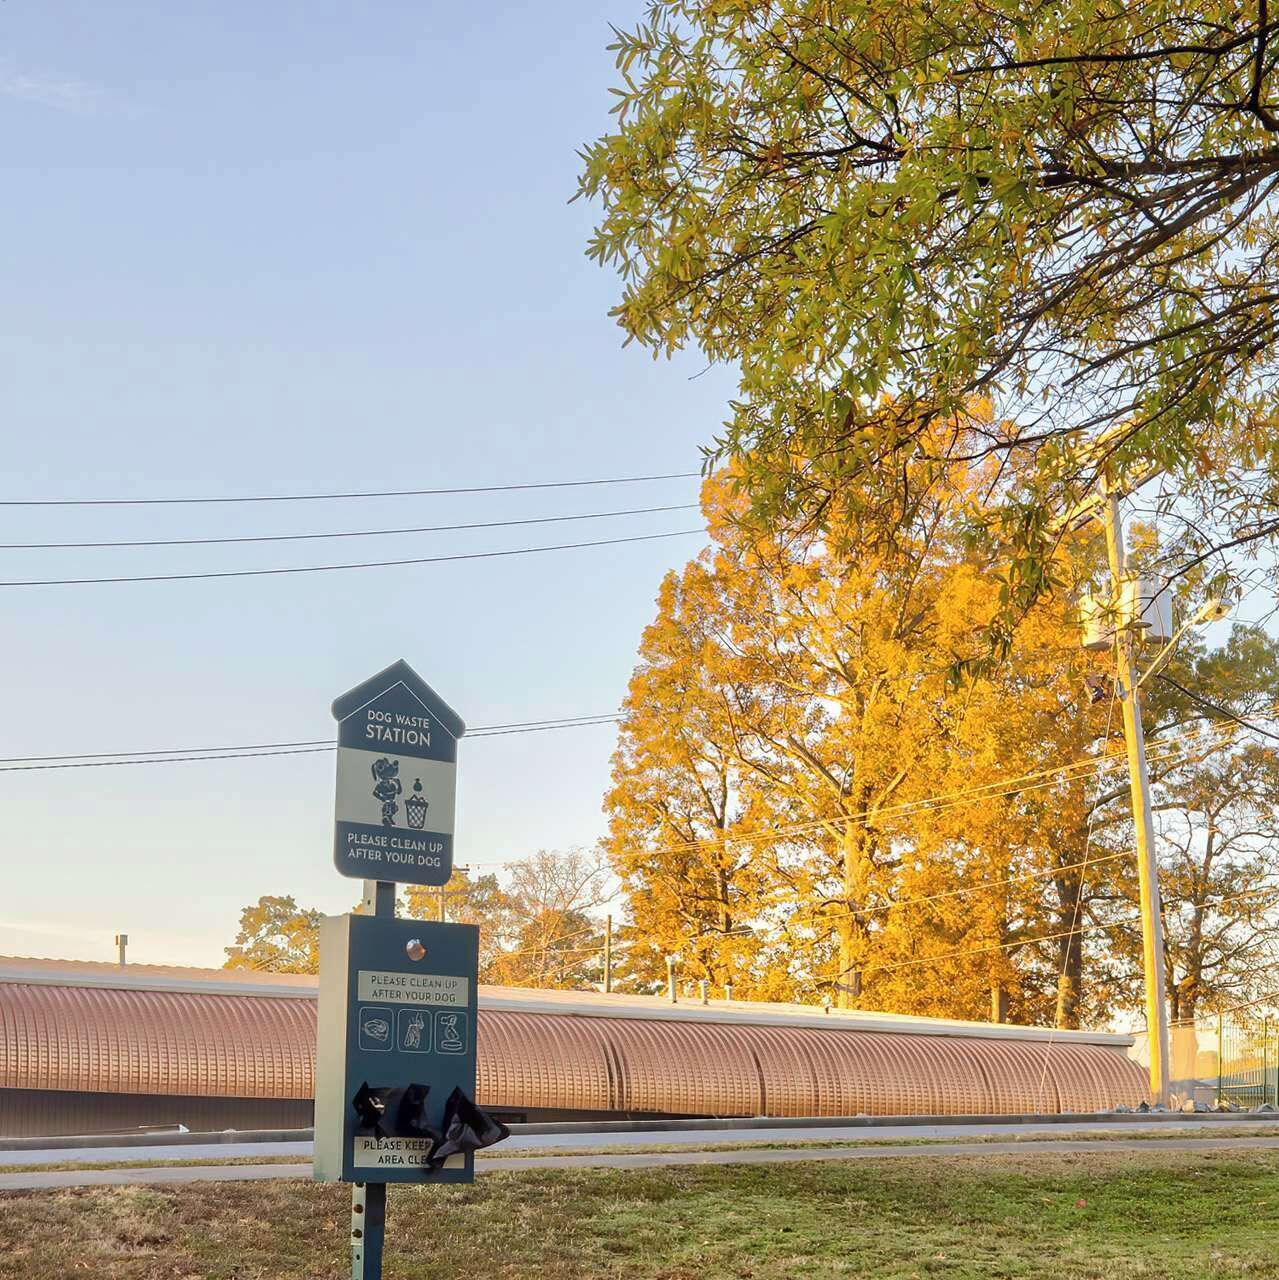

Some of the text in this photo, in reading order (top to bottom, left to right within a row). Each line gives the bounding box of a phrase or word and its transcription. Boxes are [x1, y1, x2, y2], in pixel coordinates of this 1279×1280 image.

[367, 709, 430, 729] DOG WASTE
[365, 723, 431, 748] STATION
[347, 832, 444, 854] PLEASE CLEAN UP
[347, 848, 441, 868] AFTER YOUR DOG
[371, 975, 458, 990] PLEASE CLEAN UP
[372, 987, 457, 1003] AFTER YOUR DOG
[363, 1140, 432, 1152] PLEASE KEEP
[378, 1154, 428, 1165] AREA CLE
